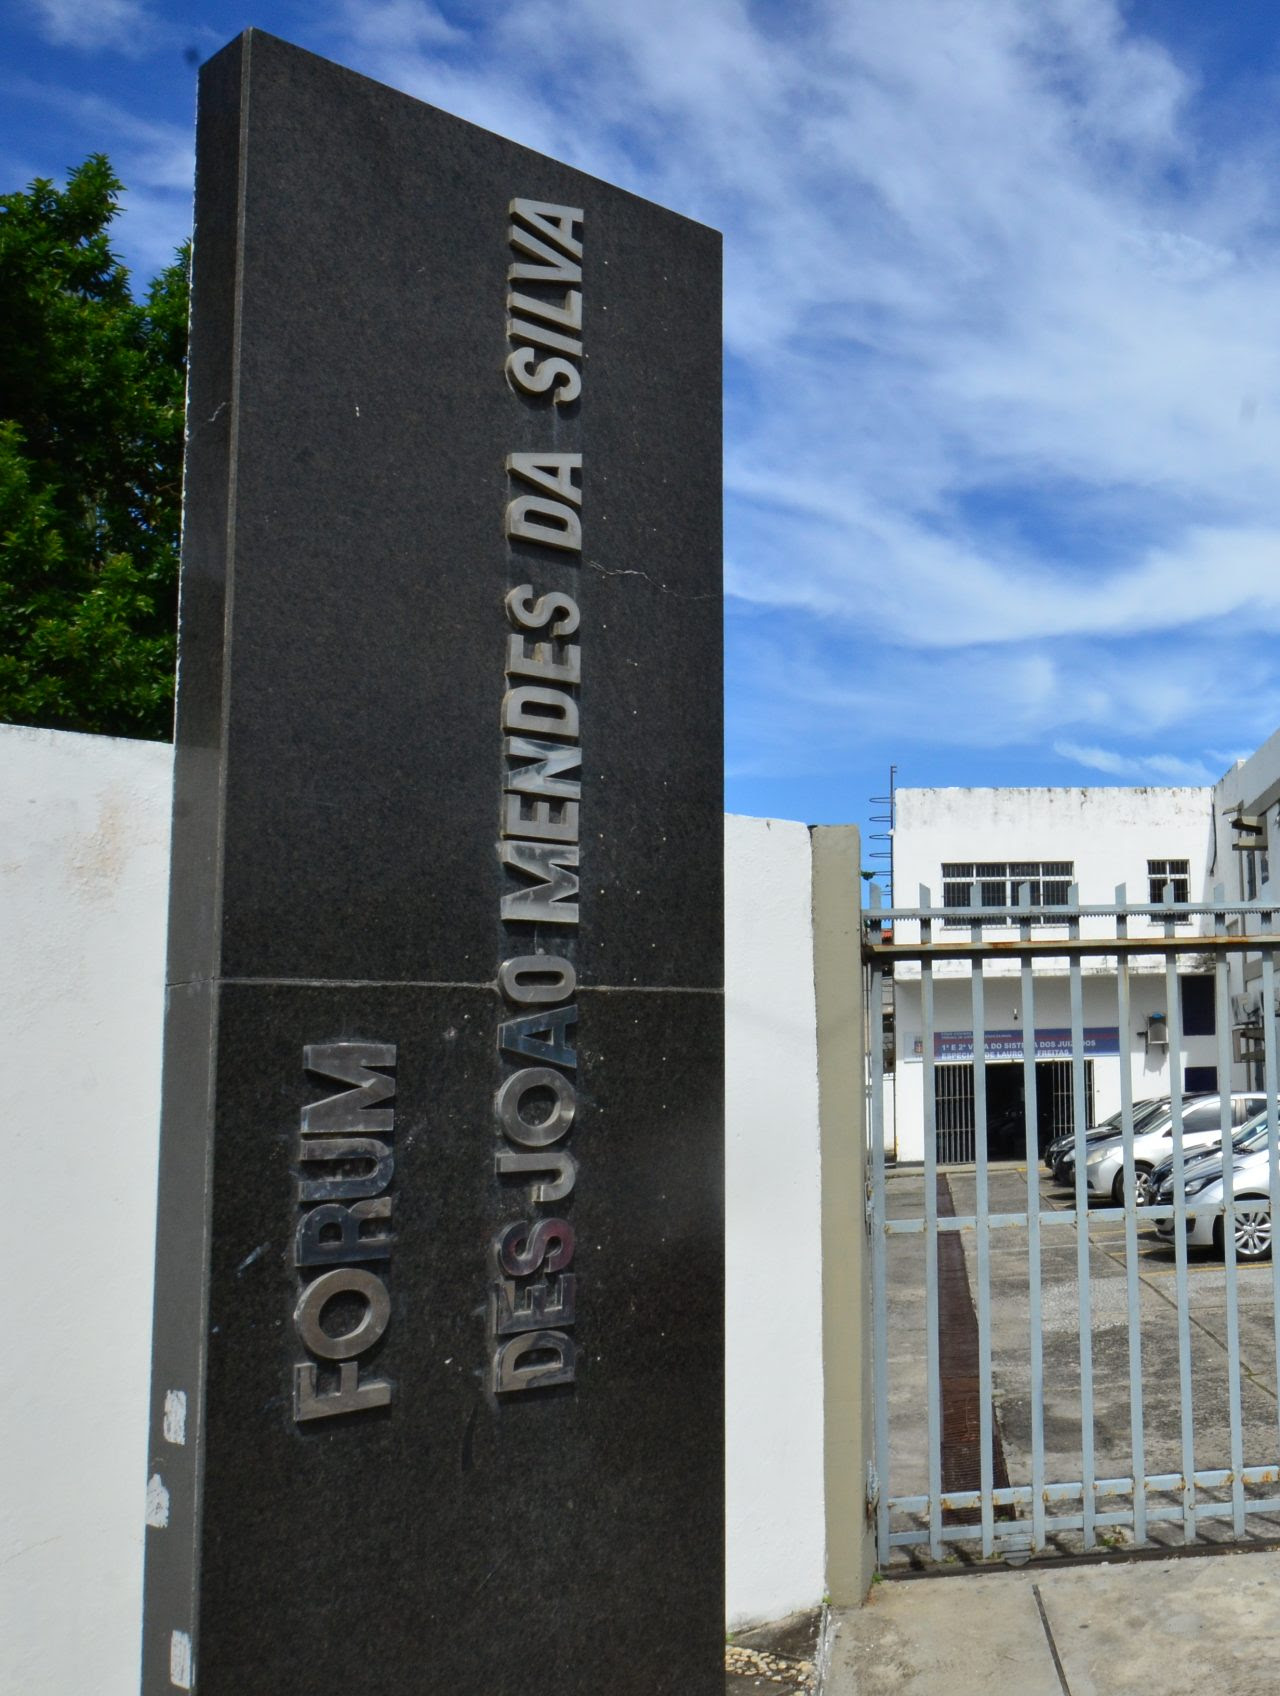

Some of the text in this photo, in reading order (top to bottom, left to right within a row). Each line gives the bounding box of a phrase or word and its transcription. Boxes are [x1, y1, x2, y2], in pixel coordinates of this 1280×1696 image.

[495, 198, 584, 1393] DES JOAO MENDES DA SILVA
[294, 1042, 397, 1421] FORUM
